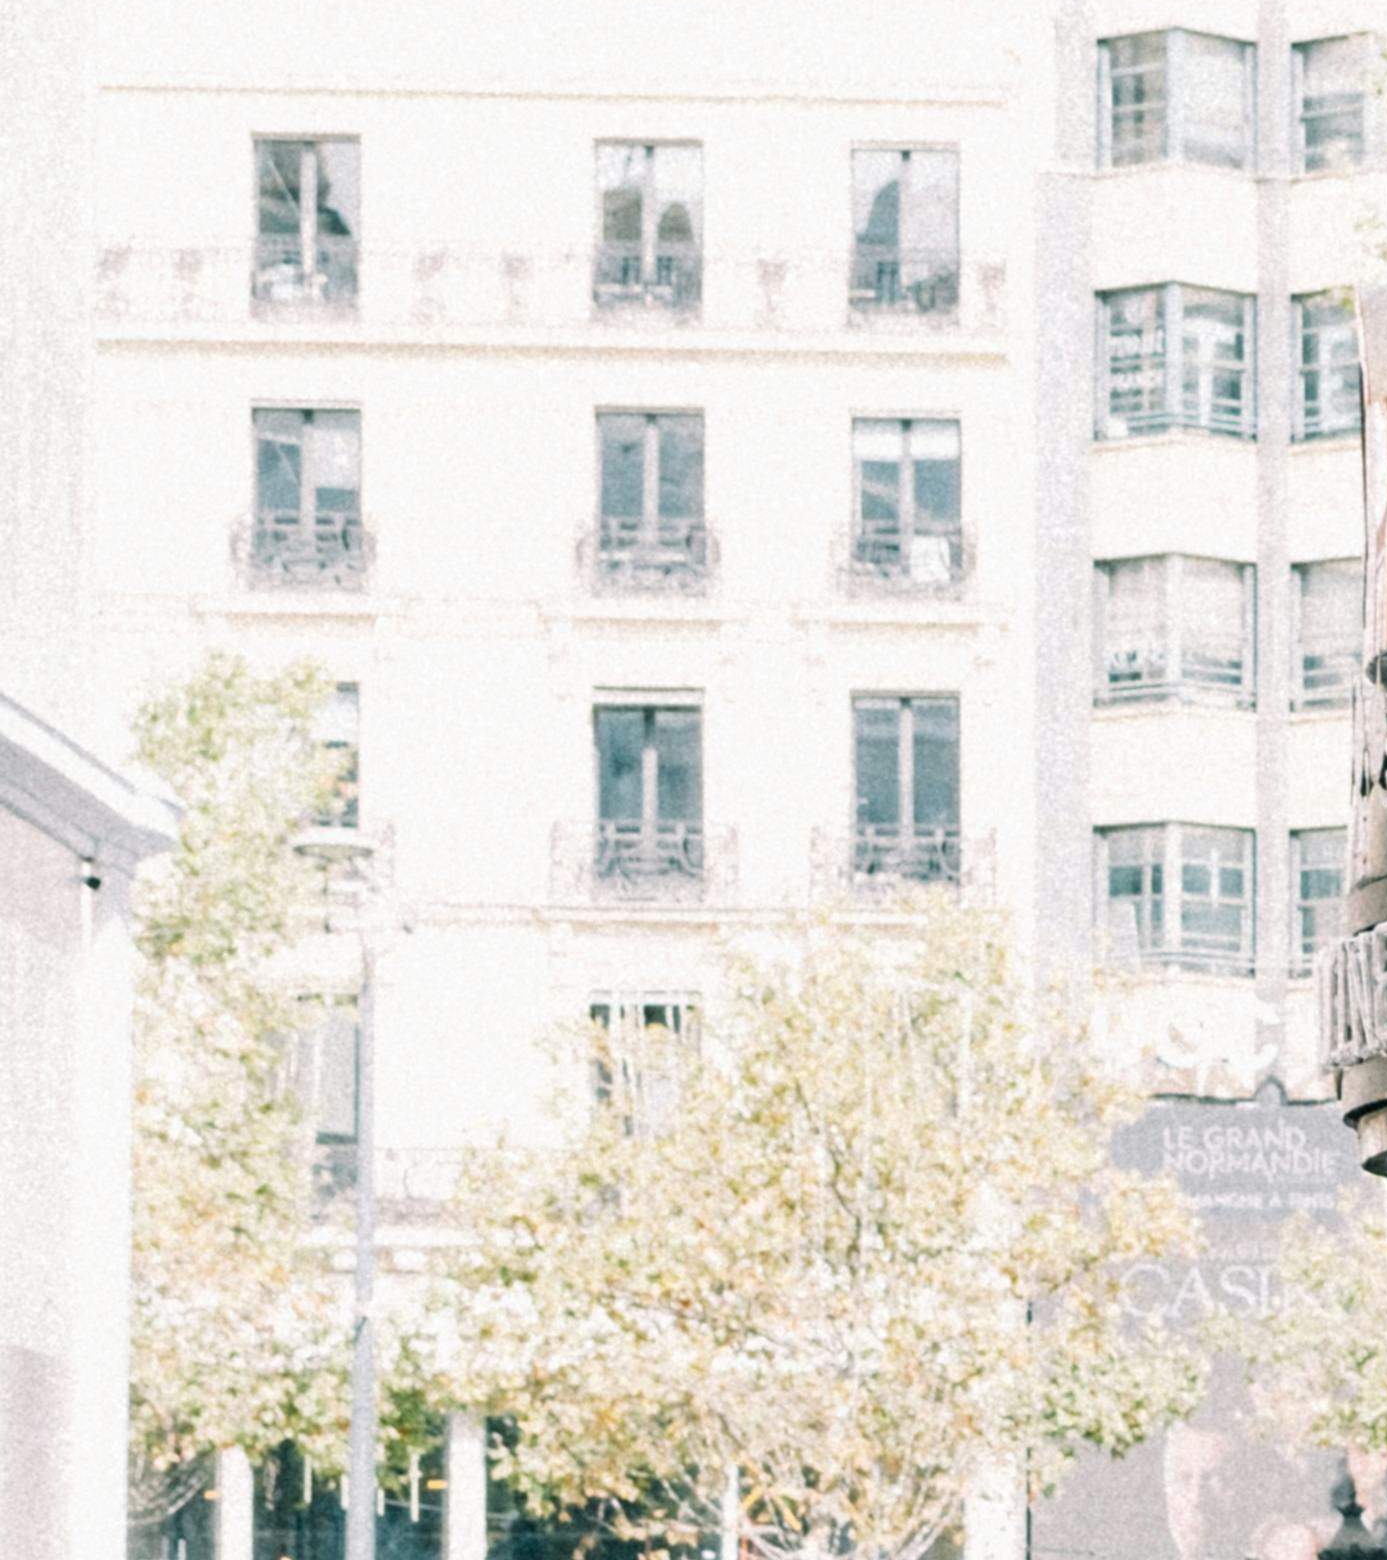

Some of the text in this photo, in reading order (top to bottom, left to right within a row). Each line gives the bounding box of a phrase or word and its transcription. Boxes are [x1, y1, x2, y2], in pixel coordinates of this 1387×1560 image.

[1163, 1117, 1307, 1157] LE GRAND
[1162, 1148, 1343, 1183] NORMANDIE
